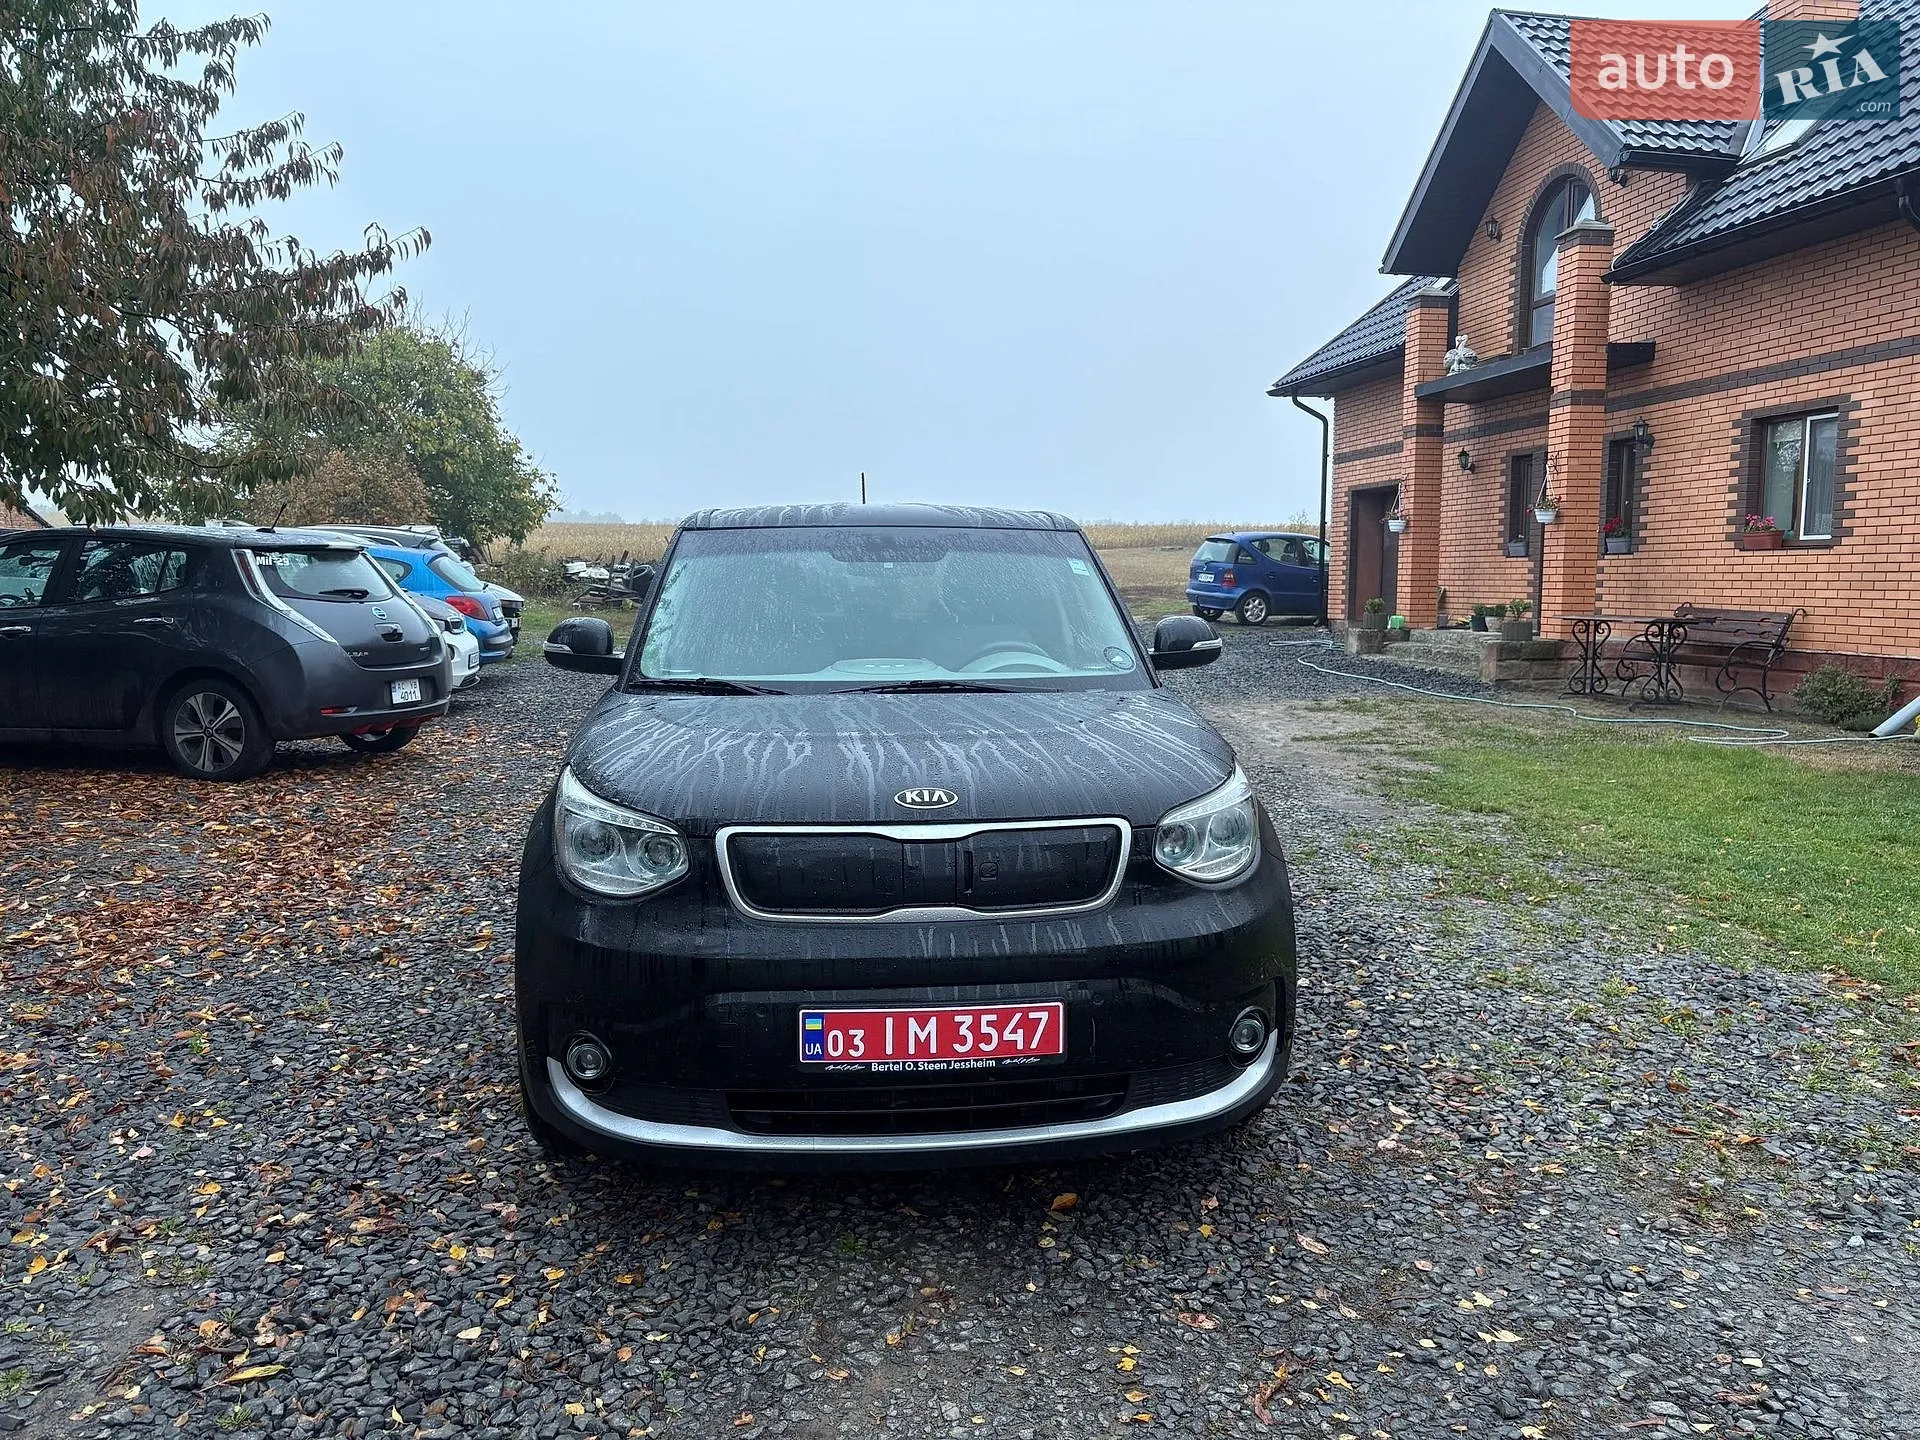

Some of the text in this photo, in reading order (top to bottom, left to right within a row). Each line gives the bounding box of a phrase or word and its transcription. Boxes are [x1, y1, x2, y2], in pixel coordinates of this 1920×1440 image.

[400, 690, 418, 701] 4011
[905, 789, 949, 803] KIA
[827, 1011, 1049, 1057] 03 IM 3547
[805, 1043, 822, 1055] UA
[871, 1062, 903, 1072] Bertel
[905, 1061, 917, 1071] O.
[918, 1061, 948, 1071] Steen
[949, 1058, 996, 1070] Jessheim
